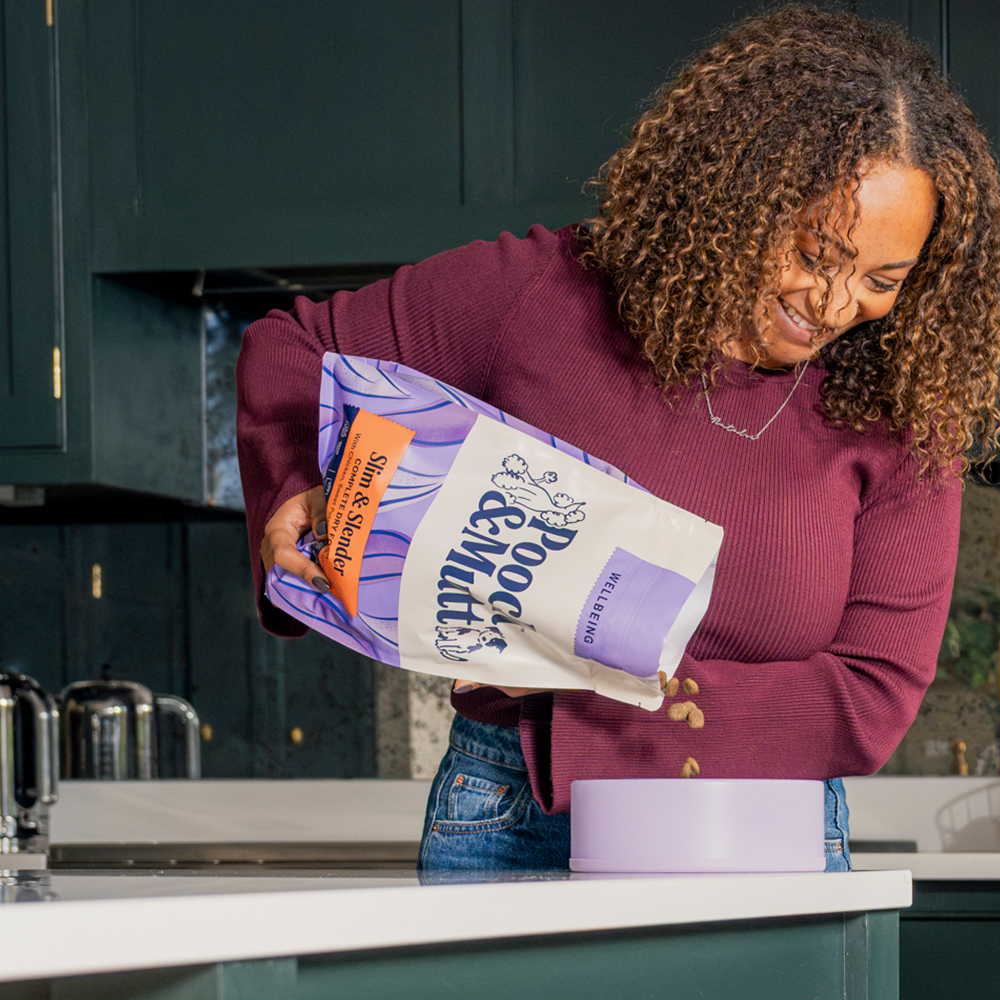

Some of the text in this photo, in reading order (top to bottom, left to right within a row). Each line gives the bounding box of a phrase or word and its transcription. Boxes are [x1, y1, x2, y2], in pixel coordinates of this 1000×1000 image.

[350, 432, 362, 450] With
[331, 483, 343, 506] Sweet
[338, 458, 362, 511] COMPLETE
[331, 511, 343, 532] DRY
[333, 451, 388, 577] Slim & Slender
[583, 572, 622, 644] WELLBEING
